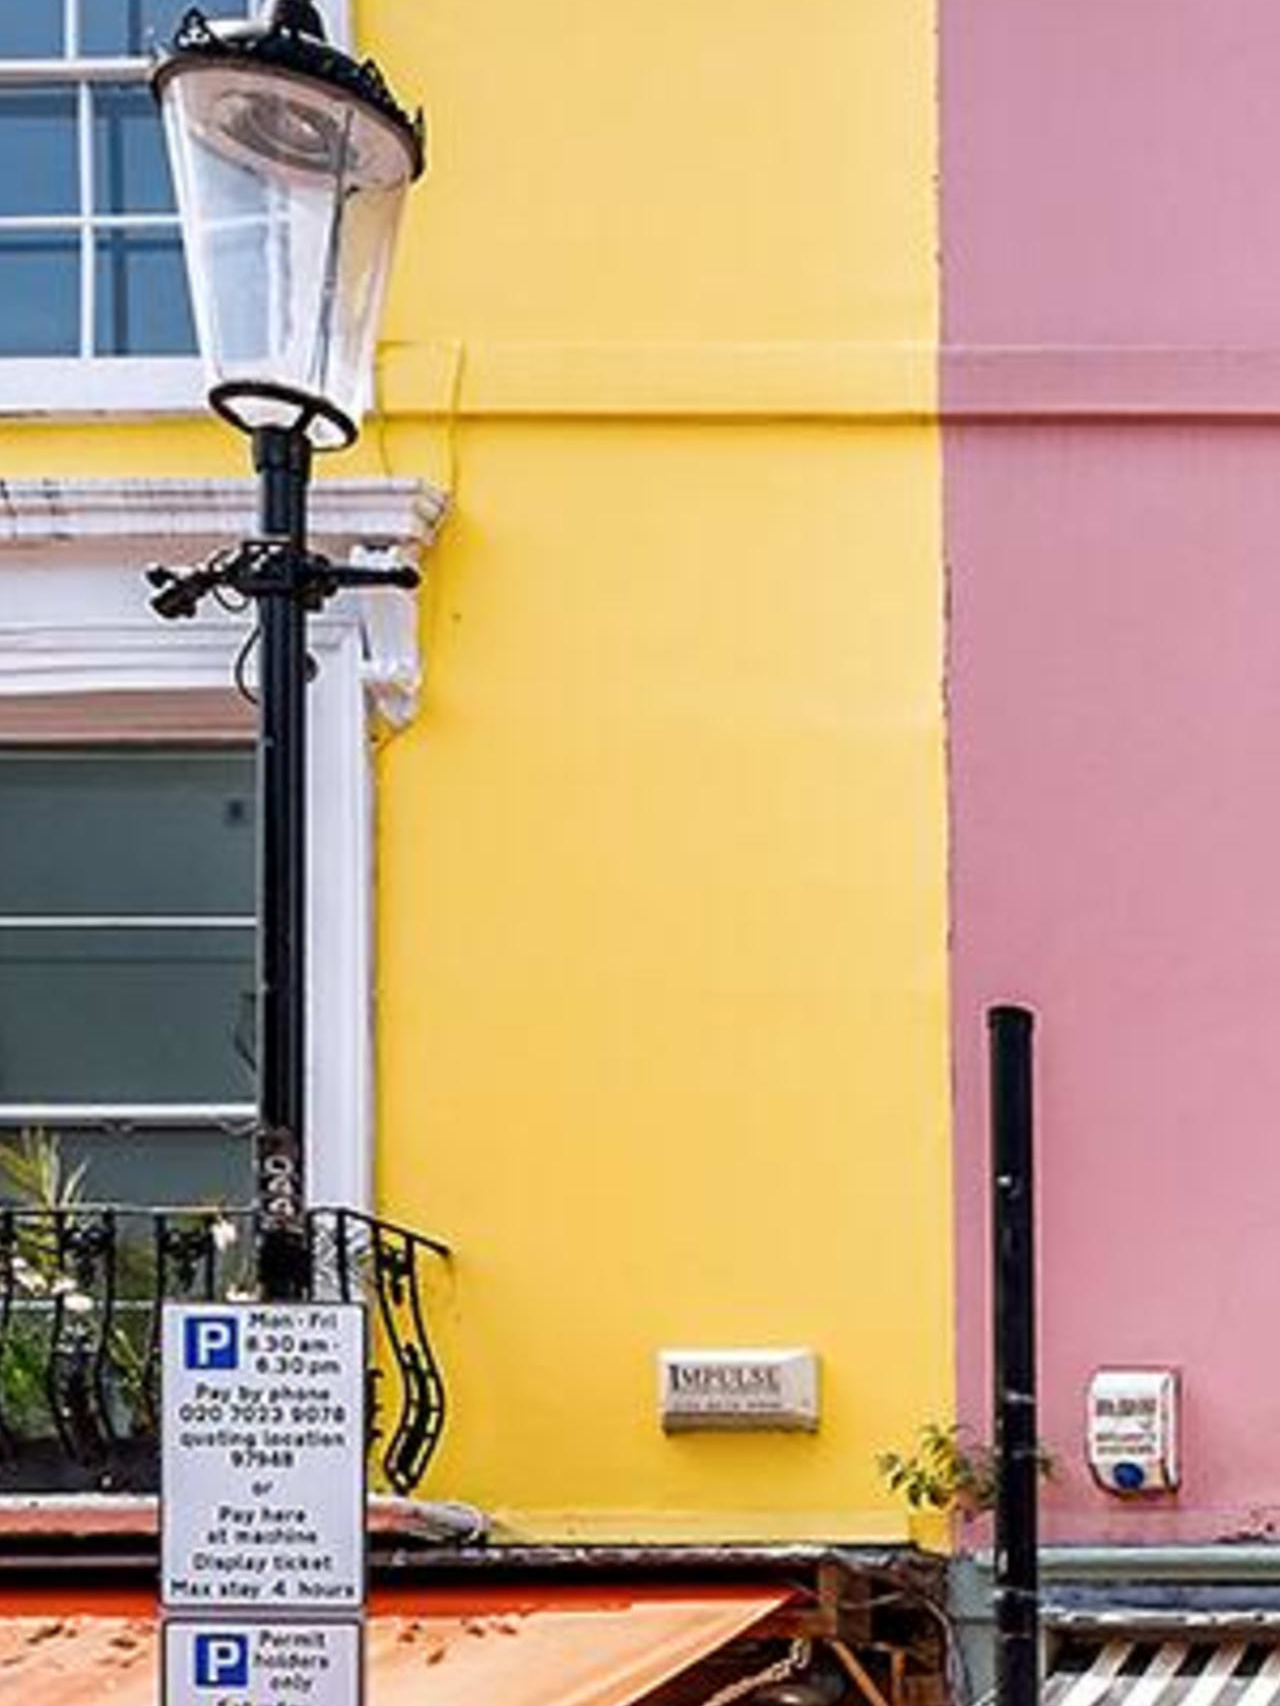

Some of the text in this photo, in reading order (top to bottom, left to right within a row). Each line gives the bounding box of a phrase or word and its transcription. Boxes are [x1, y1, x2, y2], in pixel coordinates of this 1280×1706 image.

[247, 1312, 294, 1329] Mon
[308, 1312, 338, 1329] Fri
[197, 1322, 231, 1365] P
[195, 1382, 331, 1404] Pay by phone
[179, 1429, 346, 1451] quoting location
[251, 1481, 273, 1497] or
[219, 1505, 306, 1526] Pay here
[207, 1528, 318, 1545] at machine
[193, 1552, 333, 1574] Display ticket
[171, 1578, 211, 1598] Max
[219, 1579, 261, 1600] stay
[298, 1580, 355, 1599] hours
[259, 1630, 326, 1647] Permit
[208, 1641, 240, 1682] P
[253, 1651, 329, 1670] holders
[269, 1673, 313, 1693] only
